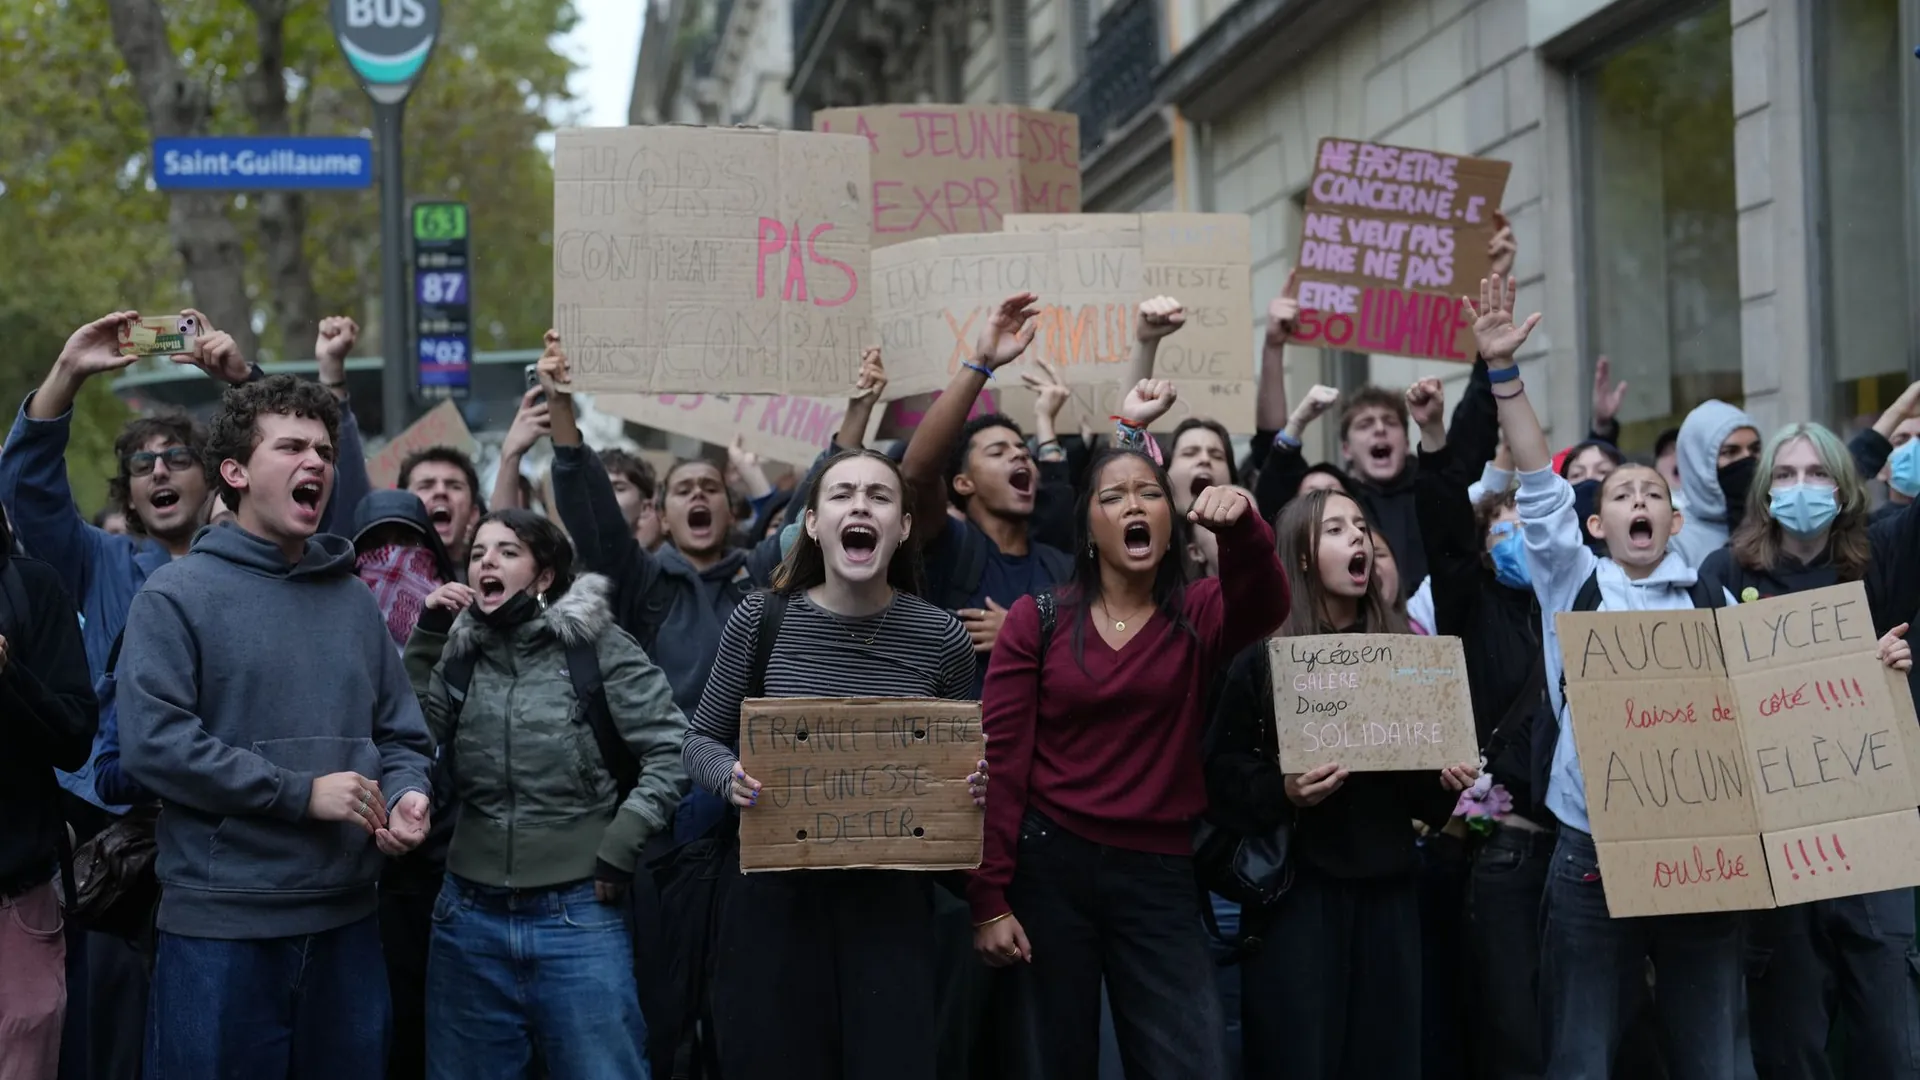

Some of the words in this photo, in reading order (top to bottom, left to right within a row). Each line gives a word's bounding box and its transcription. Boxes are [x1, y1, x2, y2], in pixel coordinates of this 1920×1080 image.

[346, 0, 425, 28] BUS
[163, 149, 362, 176] Saint-Guillaume
[900, 110, 1079, 170] JEUNESSE
[579, 144, 767, 218] HORS
[1319, 141, 1354, 171] NE
[1355, 143, 1400, 179] PAS
[1396, 151, 1459, 190] ETRE
[1304, 212, 1343, 242] NE
[1347, 217, 1410, 251] VEUT
[1408, 224, 1455, 257] PAS
[557, 229, 724, 285] CONTRAT
[756, 217, 859, 306] PAS
[1074, 252, 1127, 290] UN
[1143, 266, 1232, 290] NIFESTE
[1300, 239, 1359, 273] DIRE
[1363, 249, 1404, 280] NE
[1404, 255, 1455, 290] PAS
[422, 272, 463, 303] 87
[1297, 280, 1361, 314] ETRE
[1183, 305, 1230, 328] MES
[660, 302, 869, 385] COMBAT
[1581, 620, 1728, 678] AUCUN
[1738, 600, 1863, 663] LYCÉE
[1296, 696, 1347, 717] Diago
[1625, 699, 1698, 729] laissé
[1712, 695, 1735, 722] de
[1759, 682, 1811, 717] côté
[746, 714, 864, 756] FRANCE
[1303, 718, 1445, 752] SOLIDAIRE
[771, 764, 929, 809] JEUNESSE
[1604, 748, 1743, 812] AUCUN
[815, 807, 915, 846] DETER
[1653, 844, 1750, 889] oublié
[1783, 833, 1852, 881] !!!!
